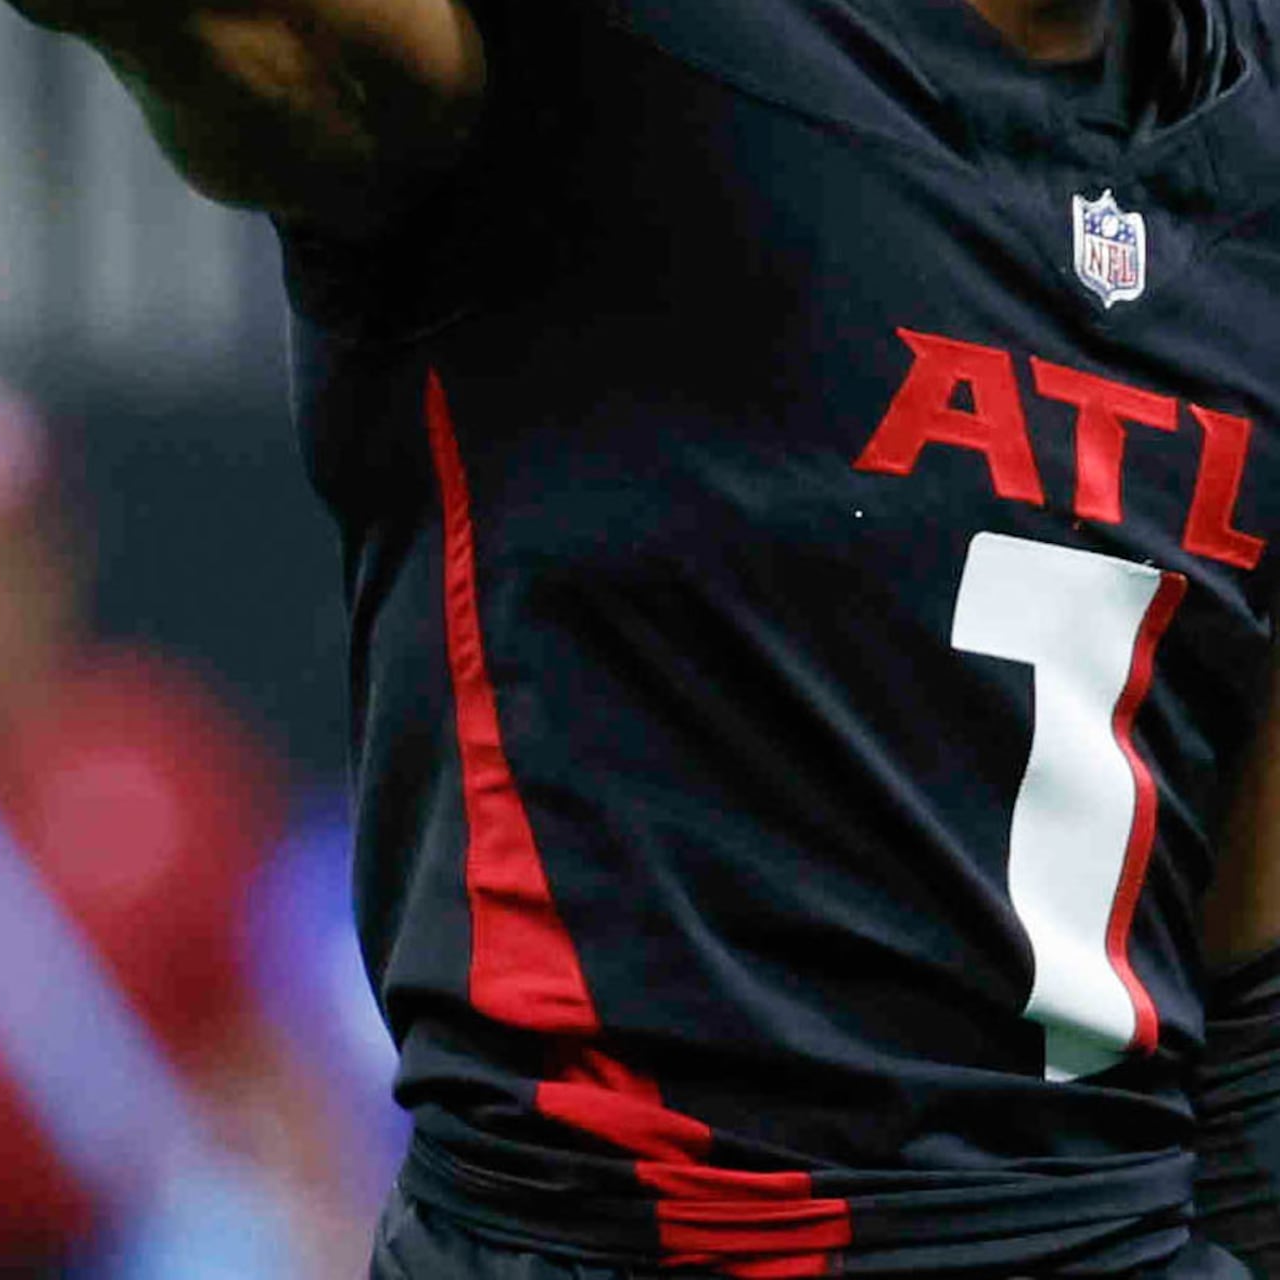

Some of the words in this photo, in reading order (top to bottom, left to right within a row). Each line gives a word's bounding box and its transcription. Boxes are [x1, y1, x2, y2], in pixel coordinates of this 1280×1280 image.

[1088, 240, 1135, 283] NFL
[853, 326, 1267, 571] ATL
[950, 530, 1188, 1082] 1
